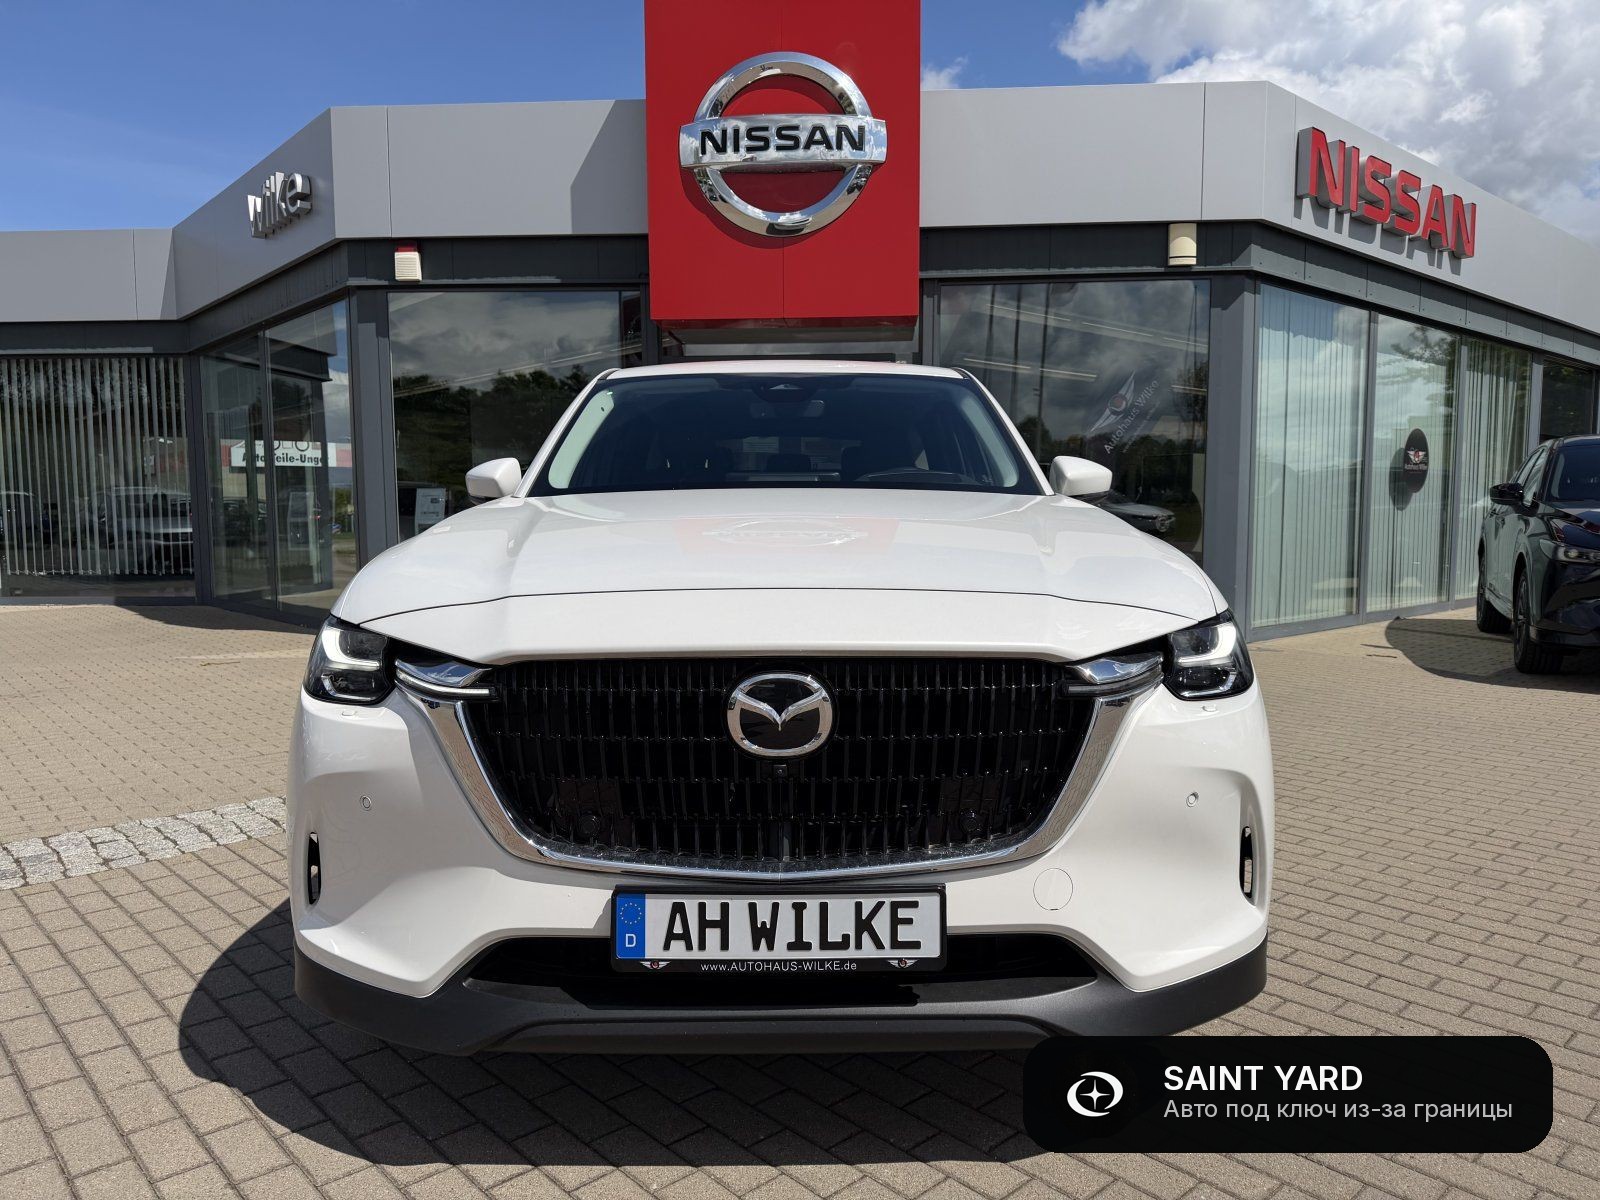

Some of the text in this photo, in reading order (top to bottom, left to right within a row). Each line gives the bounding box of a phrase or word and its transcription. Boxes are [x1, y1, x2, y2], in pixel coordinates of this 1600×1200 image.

[699, 125, 866, 156] NISSAN
[1296, 126, 1477, 259] NISSAN
[1103, 407, 1140, 454] Autohaus
[625, 933, 637, 948] D
[662, 900, 922, 951] AH WILKE
[700, 960, 857, 972] www.AUTOHAUS-WILKE.de
